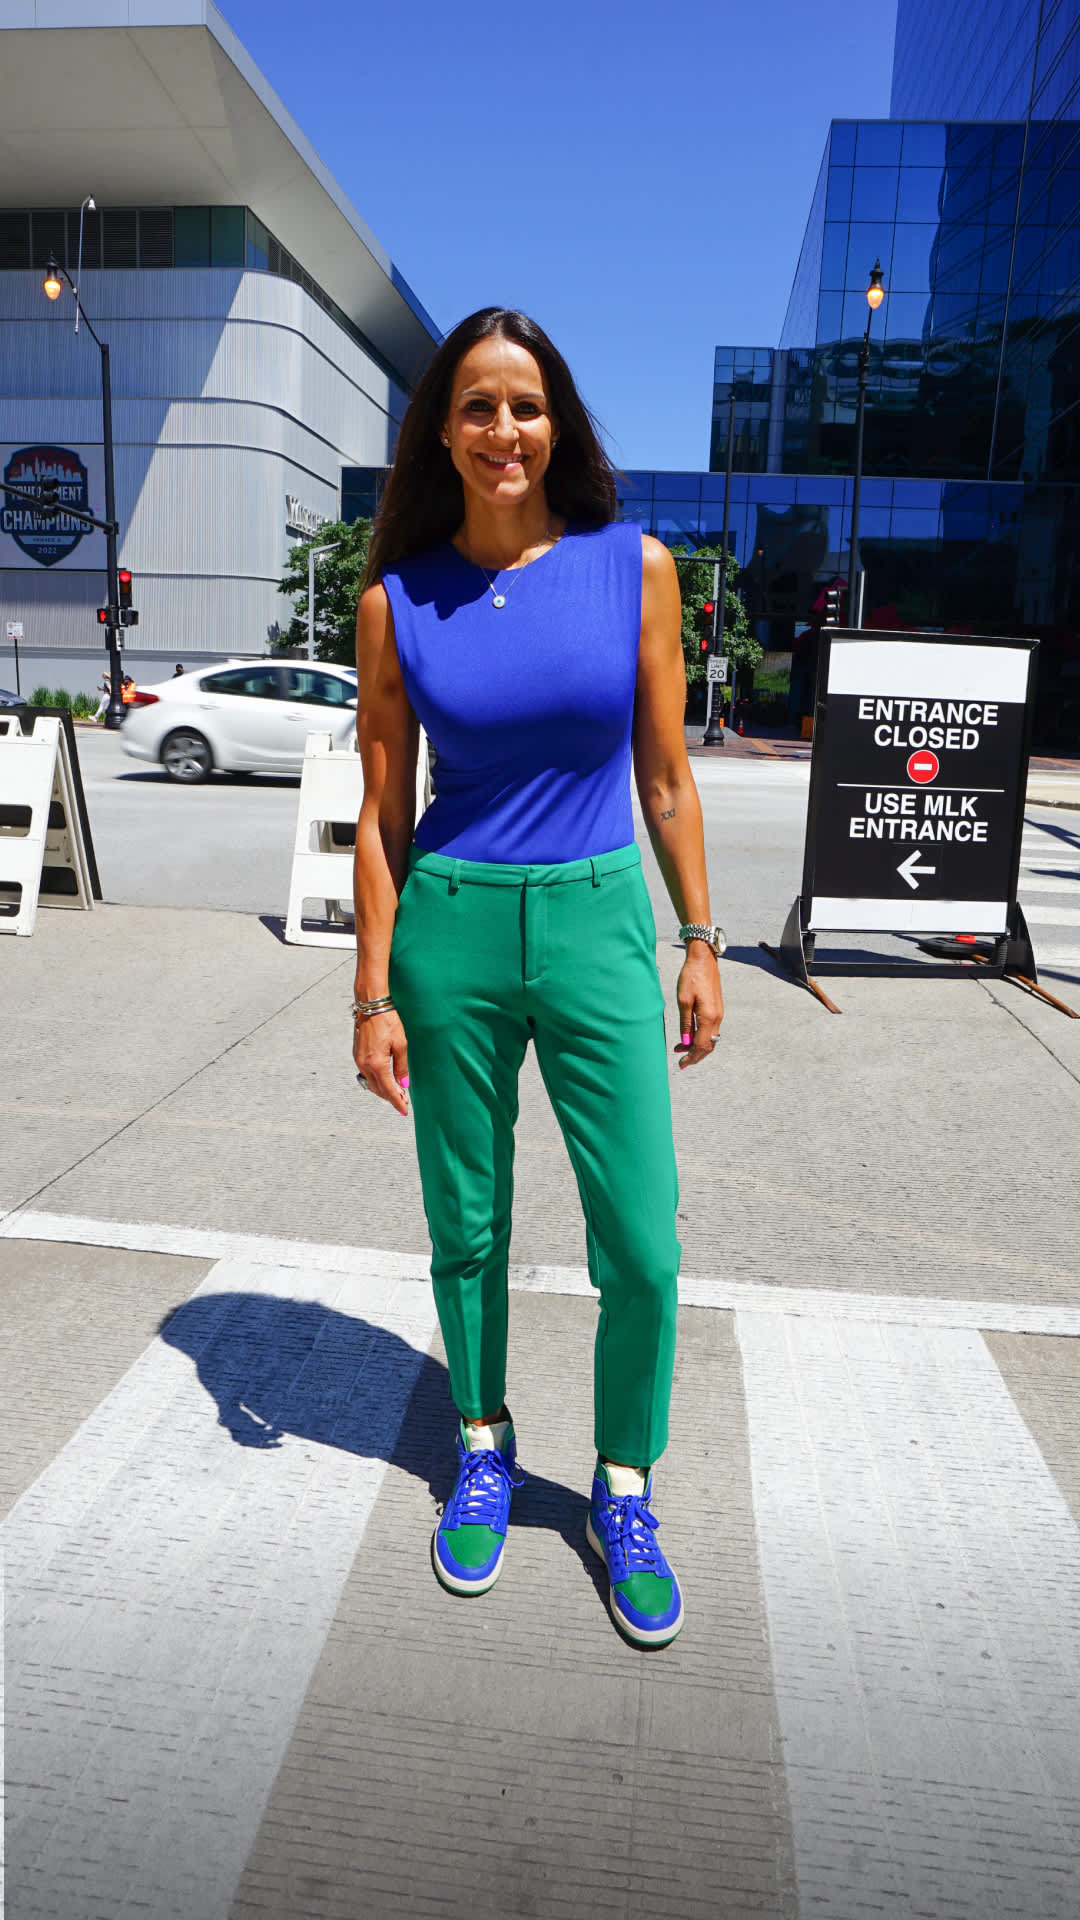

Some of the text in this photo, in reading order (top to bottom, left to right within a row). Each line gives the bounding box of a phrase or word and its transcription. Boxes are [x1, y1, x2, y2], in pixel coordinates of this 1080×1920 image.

[710, 669, 725, 678] 20
[858, 698, 999, 725] ENTRANCE
[874, 725, 980, 750] CLOSED
[865, 793, 978, 817] USE MLK
[849, 817, 989, 842] ENTRANCE
